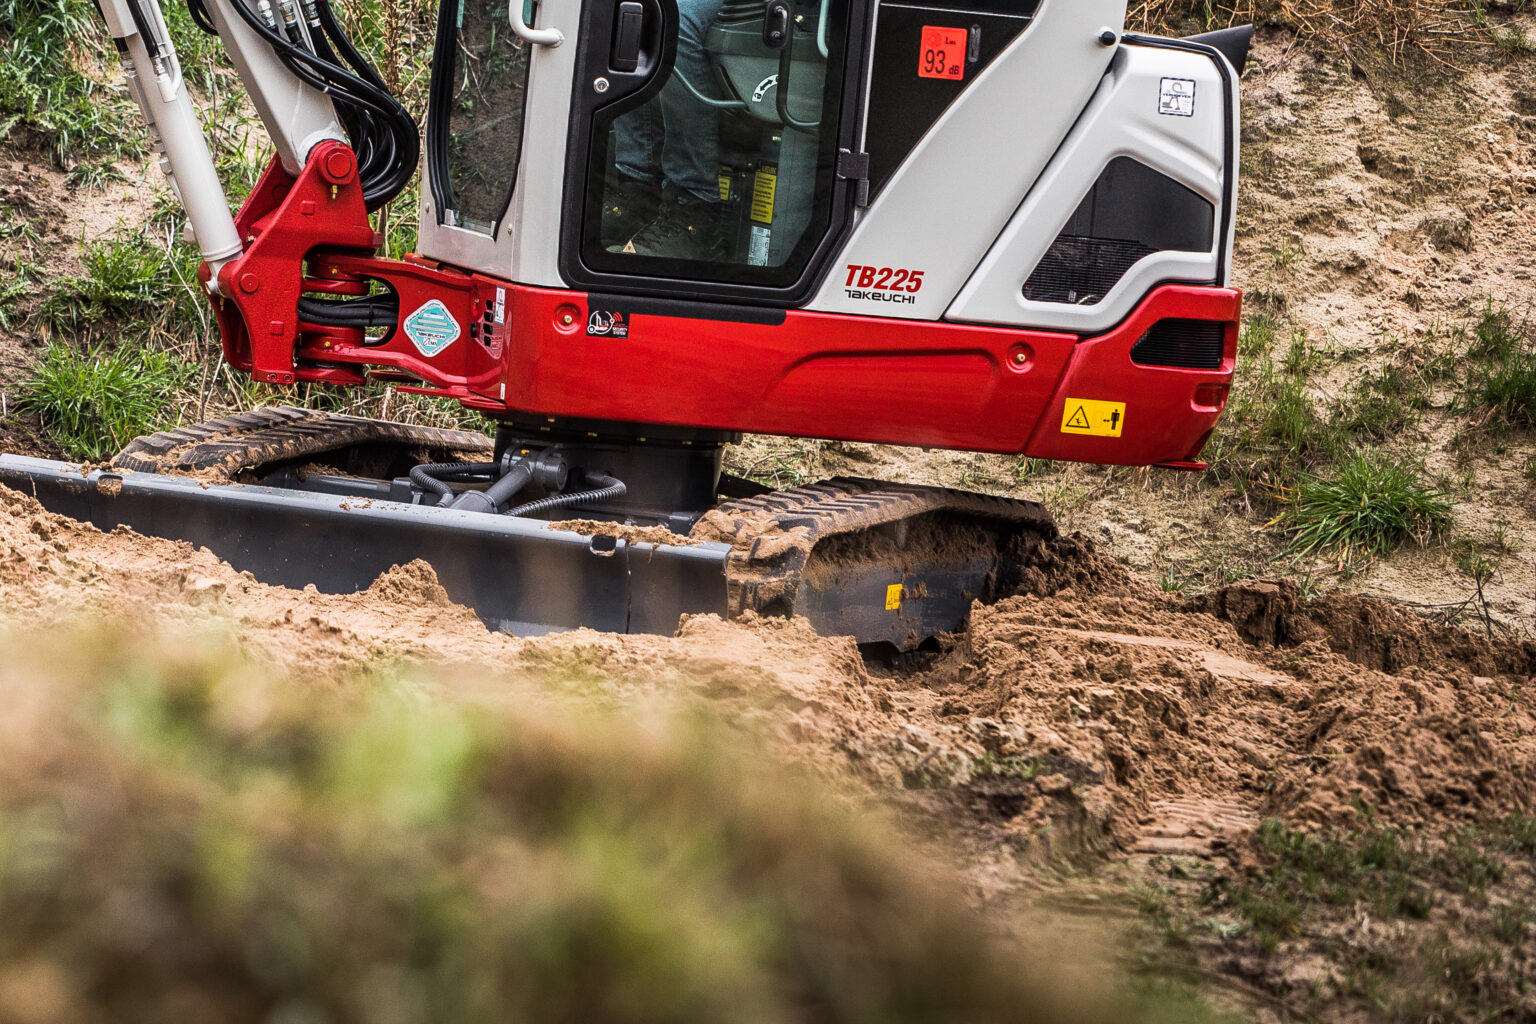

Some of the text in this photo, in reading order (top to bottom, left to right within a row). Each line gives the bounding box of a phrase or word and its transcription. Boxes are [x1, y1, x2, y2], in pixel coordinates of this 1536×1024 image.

[925, 49, 960, 75] 93 dB
[845, 264, 925, 293] TB225
[844, 289, 916, 304] TAKEUCHI
